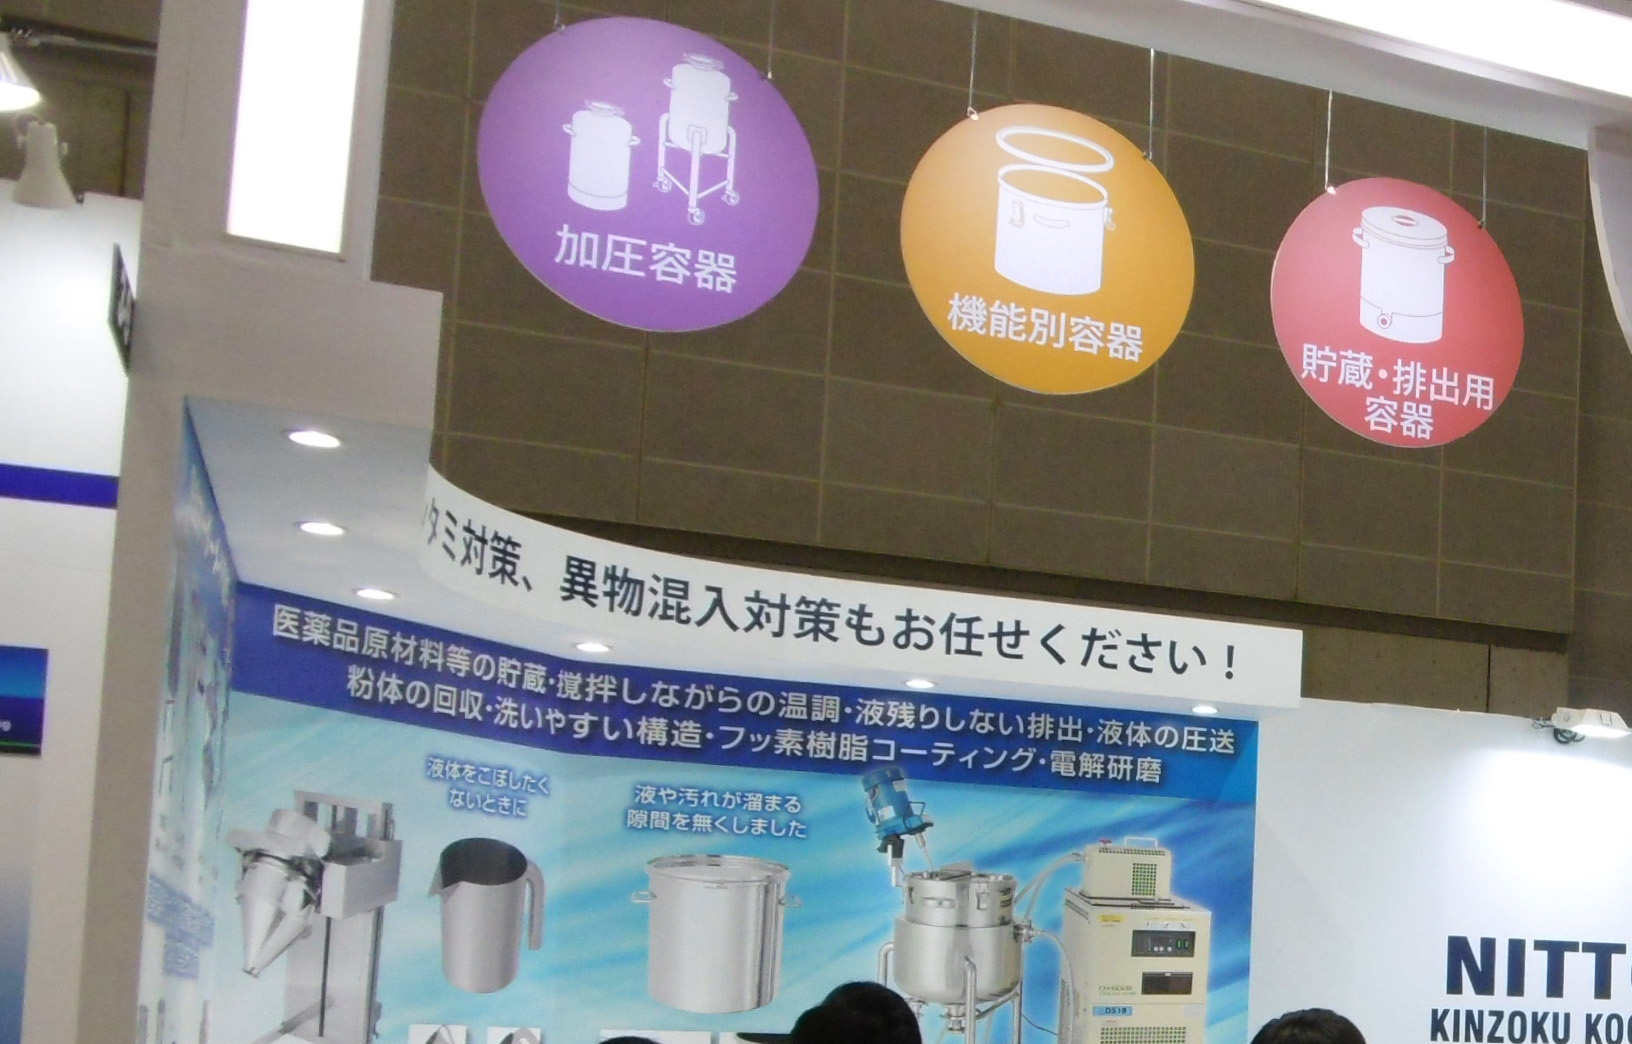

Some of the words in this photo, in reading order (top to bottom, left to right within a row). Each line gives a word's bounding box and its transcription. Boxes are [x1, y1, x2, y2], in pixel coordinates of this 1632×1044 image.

[555, 223, 737, 294] 加圧容器
[947, 292, 1144, 363] 機能別容器
[1300, 342, 1496, 411] 貯蔵・排出用
[1364, 395, 1434, 440] 容器
[422, 497, 1236, 681] タミ対策、異物混入対策もお任せください！
[427, 756, 550, 796] 液体をこぼしたく
[449, 787, 528, 818] ないときに
[634, 784, 802, 814] 液や汚れが溜まる
[627, 808, 807, 839] 隙間を無くしました
